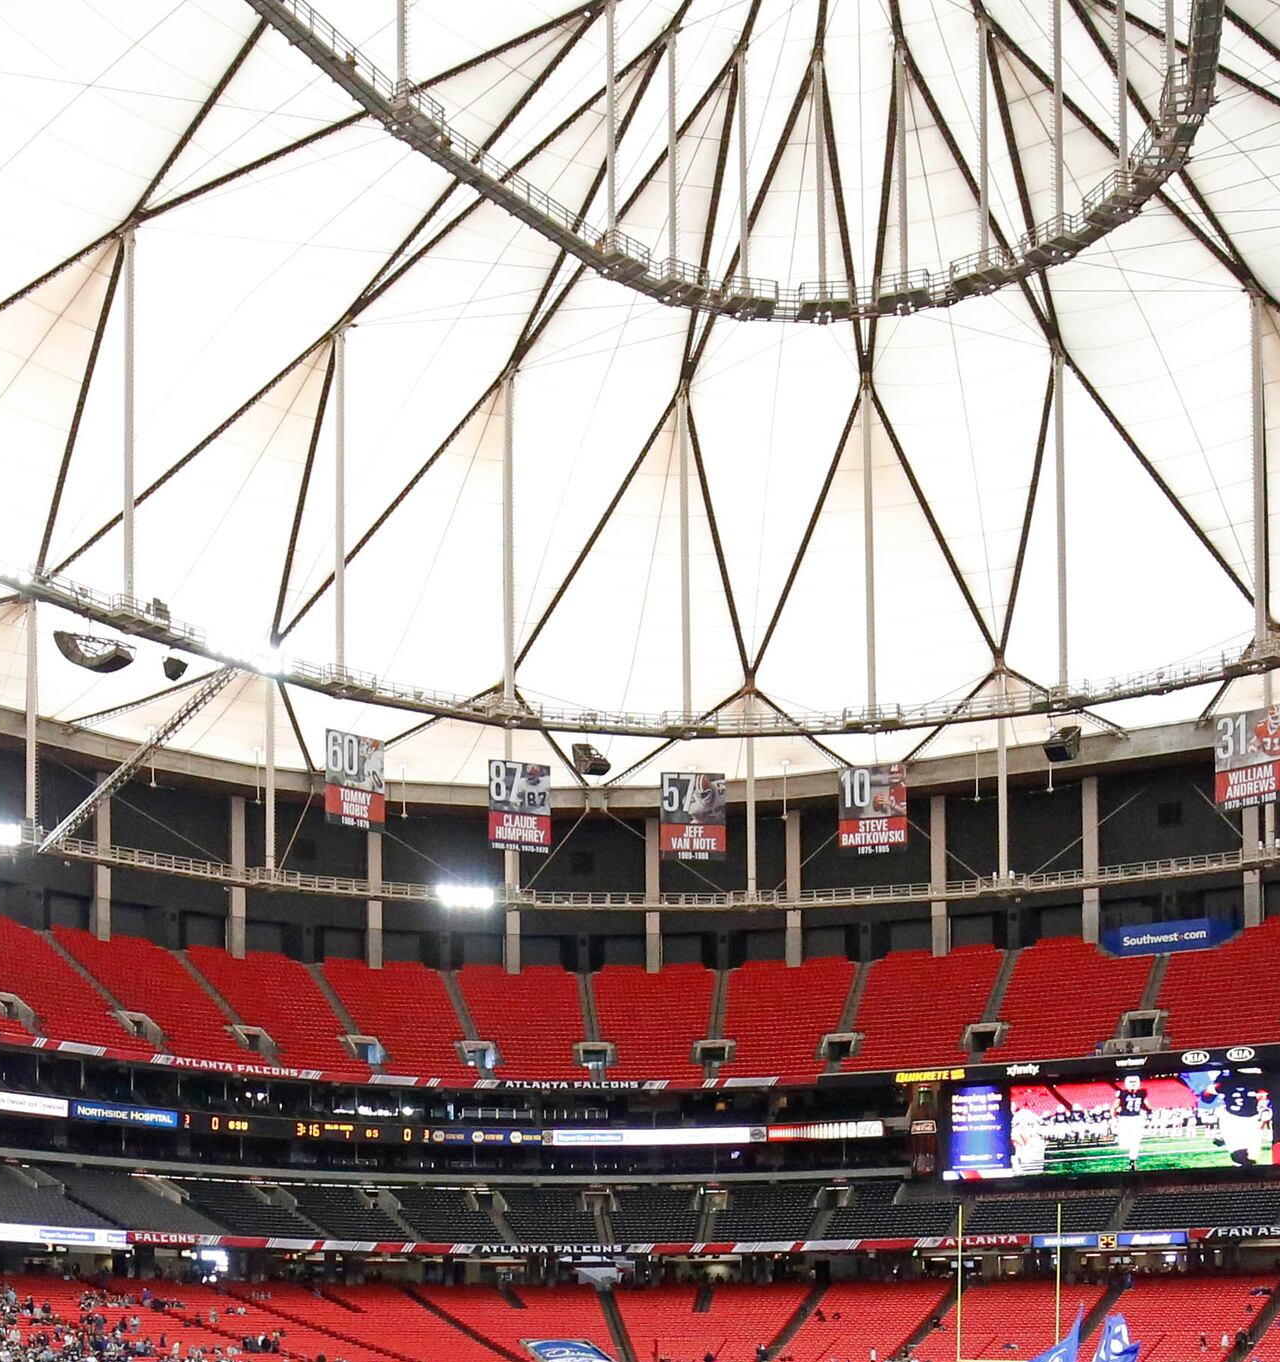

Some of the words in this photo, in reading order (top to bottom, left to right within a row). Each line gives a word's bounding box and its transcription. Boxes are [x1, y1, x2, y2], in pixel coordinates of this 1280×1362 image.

[1216, 714, 1247, 760] 31
[327, 731, 359, 776] 60
[489, 760, 523, 804] 87
[1228, 764, 1273, 786] WILLIAM
[339, 788, 371, 805] TOMMY
[662, 773, 696, 813] 57
[840, 768, 871, 809] 10
[1225, 777, 1276, 800] ANDREWS
[342, 801, 369, 818] NOBIS
[503, 813, 538, 830] CLAUDE
[858, 819, 889, 832] STEVE
[495, 826, 545, 844] HUMPHREY
[683, 825, 704, 837] JEFF
[841, 830, 905, 844] BARTKOWSKI
[671, 836, 690, 850] VAN
[692, 837, 716, 850] NOTE
[176, 1056, 233, 1071] ATLANTA
[237, 1063, 298, 1077] FALCONS
[505, 1080, 568, 1089] ATLANTA
[574, 1080, 639, 1089] FALCONS
[895, 1070, 950, 1083] QUIKRETE
[77, 1105, 128, 1119] NORTHSIDE
[131, 1111, 174, 1124] HOSPITAL
[211, 1116, 220, 1131] 0
[296, 1122, 320, 1137] 3:16
[403, 1128, 412, 1142] 0
[134, 1231, 195, 1243] FALCONS
[1217, 1226, 1253, 1237] FAN
[481, 1244, 548, 1253] ATLANTA
[554, 1244, 623, 1253] FALCONS
[945, 1235, 1018, 1246] ATLANTA
[1099, 1235, 1116, 1249] 25
